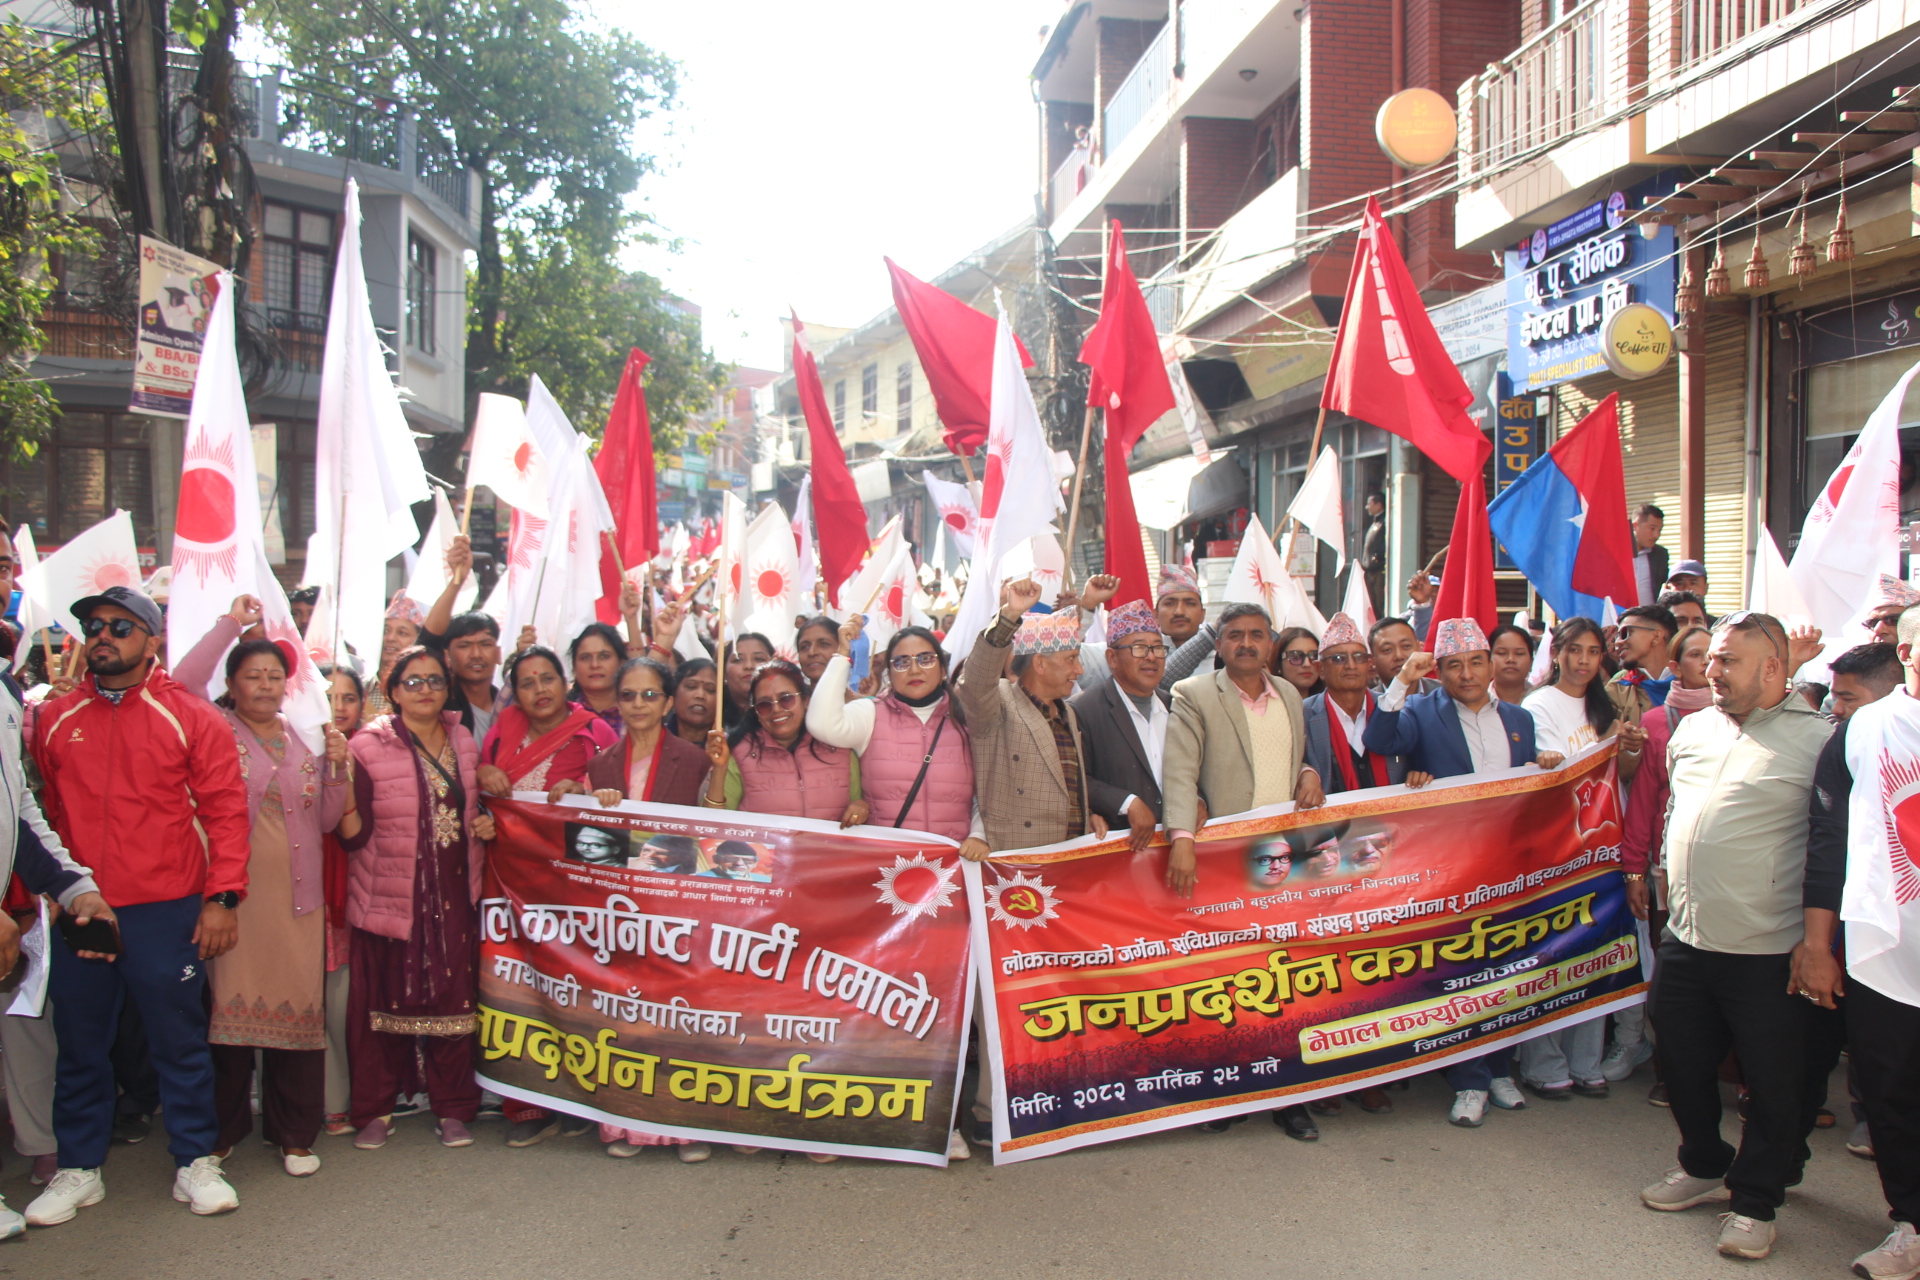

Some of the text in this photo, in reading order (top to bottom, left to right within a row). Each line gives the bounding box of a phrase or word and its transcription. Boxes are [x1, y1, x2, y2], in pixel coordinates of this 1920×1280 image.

[1569, 234, 1626, 286] सैनिक
[154, 346, 202, 365] BBA/B
[1584, 352, 1606, 370] DENTA
[1616, 340, 1650, 354] Coffee
[694, 824, 719, 834] एक
[1002, 944, 1115, 976] लोकतन्त्रको
[1170, 924, 1262, 956] संविधानको
[1306, 912, 1354, 937] संसद
[1464, 874, 1525, 912] प्रतिगामी
[1250, 890, 1303, 909] बहुदलीय
[520, 894, 699, 964] कम्युनिष्ट
[708, 922, 801, 982] पार्टी
[803, 946, 940, 1040] (एमाले)
[1019, 892, 1596, 1039] जनप्रदर्शन कार्यक्रम
[1442, 954, 1540, 992] आयोजक
[1307, 942, 1635, 1054] नेपाल कम्युनिष्ट पार्टी (एमाले)
[1412, 1026, 1472, 1053] जिल्ला
[1544, 988, 1588, 1013] पाल्पा
[765, 1013, 841, 1043] पाल्पा
[668, 1053, 933, 1122] कार्यक्रम
[1072, 1080, 1126, 1110] २०८२
[1135, 1068, 1204, 1093] कार्तिक
[1213, 1065, 1240, 1086] २९
[1251, 1056, 1282, 1076] गते
